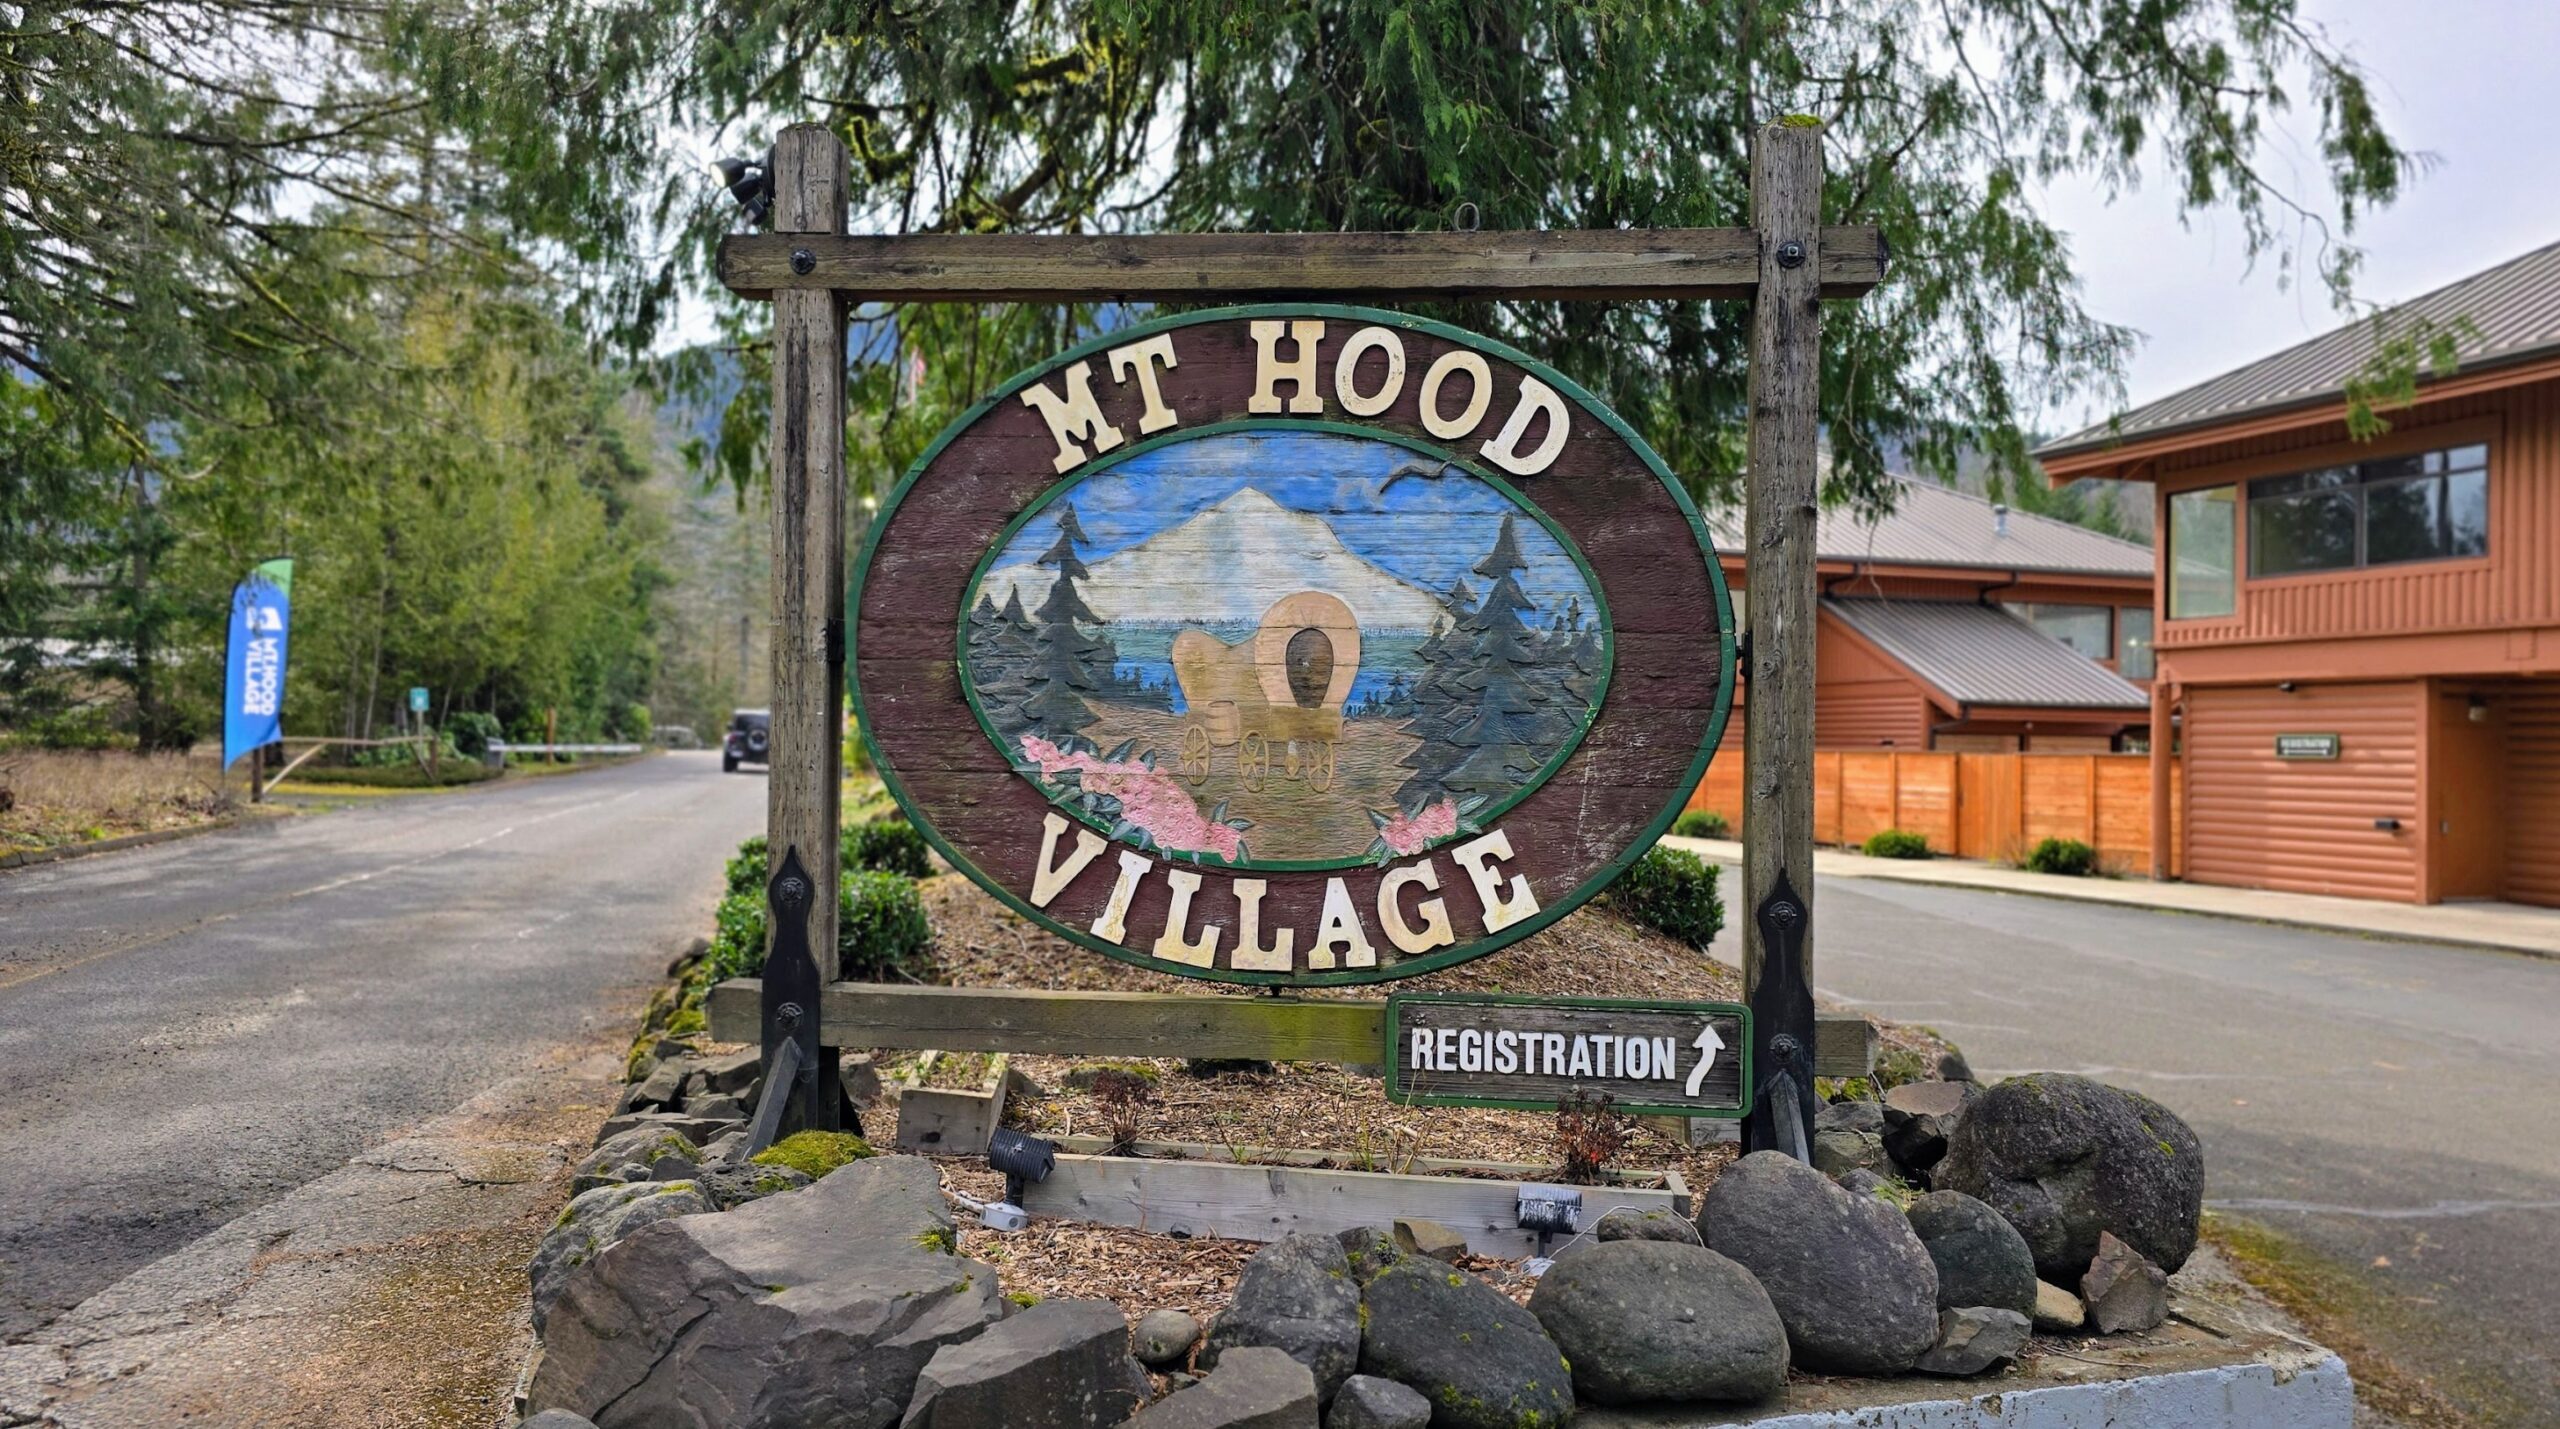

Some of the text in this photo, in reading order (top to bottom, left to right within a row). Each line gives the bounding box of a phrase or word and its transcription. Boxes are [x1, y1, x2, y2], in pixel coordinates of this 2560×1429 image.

[1020, 320, 1570, 476] MT HOOD
[243, 640, 263, 716] VILLAGE
[1030, 812, 1540, 972] VILLAGE
[1410, 1027, 1676, 1081] REGISTRATION
